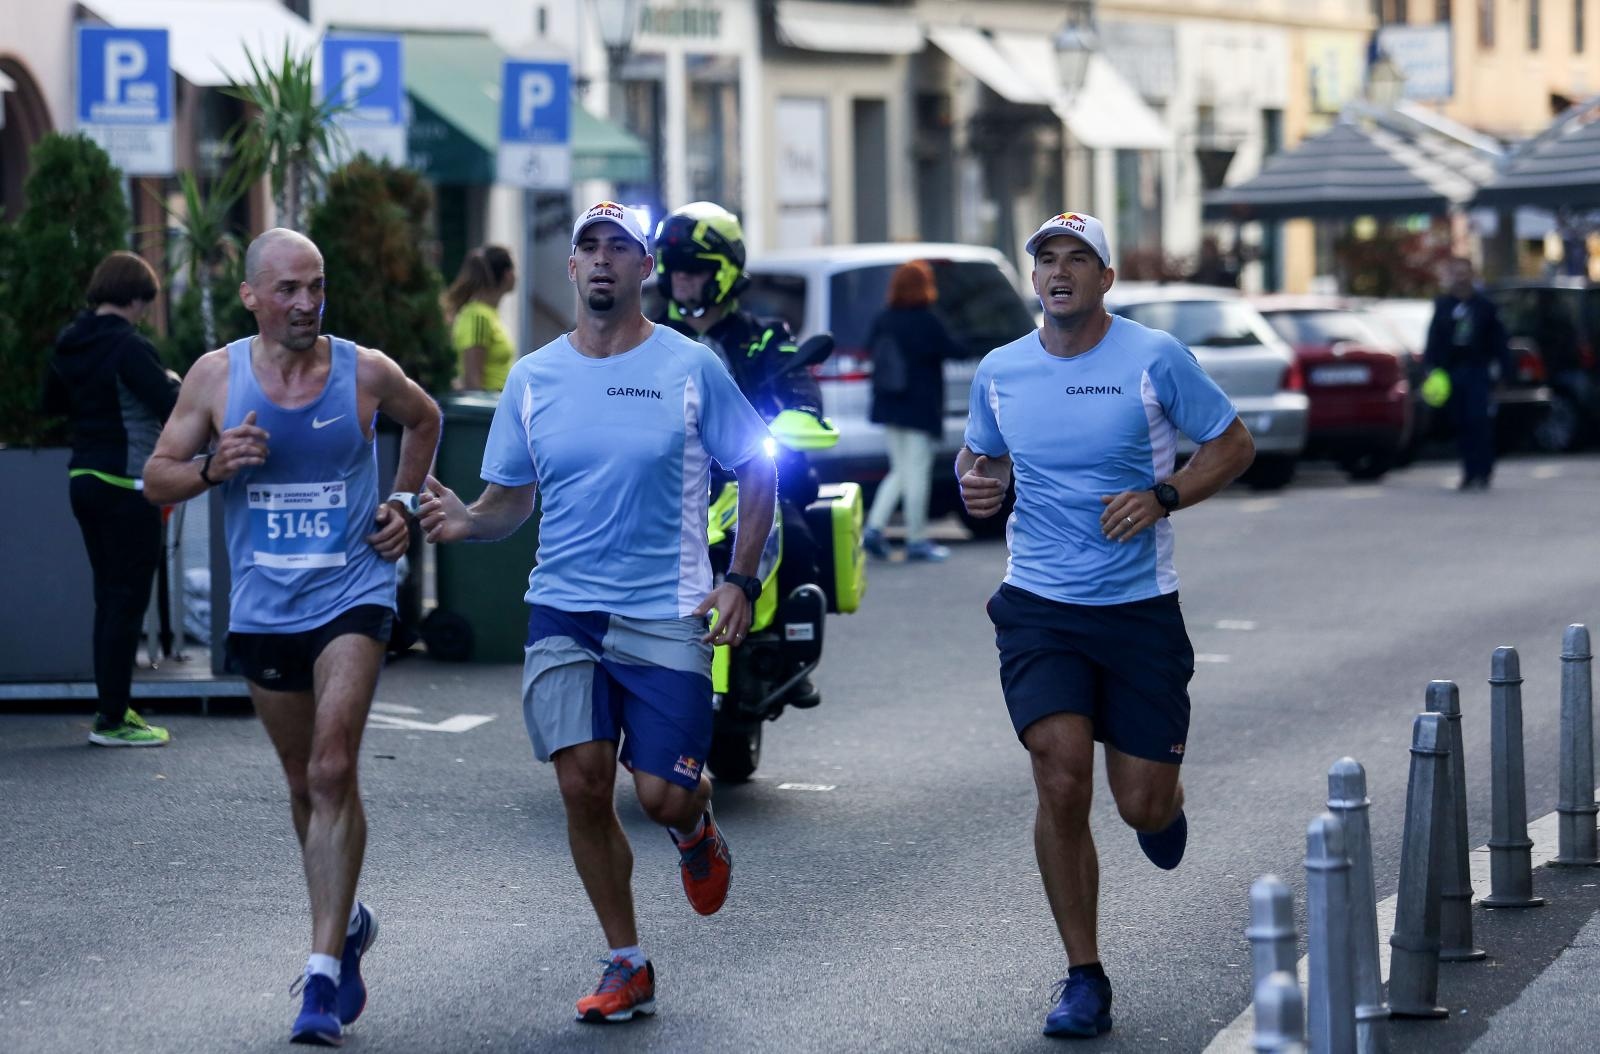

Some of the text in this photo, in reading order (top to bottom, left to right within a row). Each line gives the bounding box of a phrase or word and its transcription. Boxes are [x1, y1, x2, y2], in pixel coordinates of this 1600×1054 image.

[104, 38, 147, 102] P
[341, 48, 382, 107] P
[518, 71, 555, 128] P
[605, 209, 624, 219] Bull
[267, 511, 331, 539] 5146
